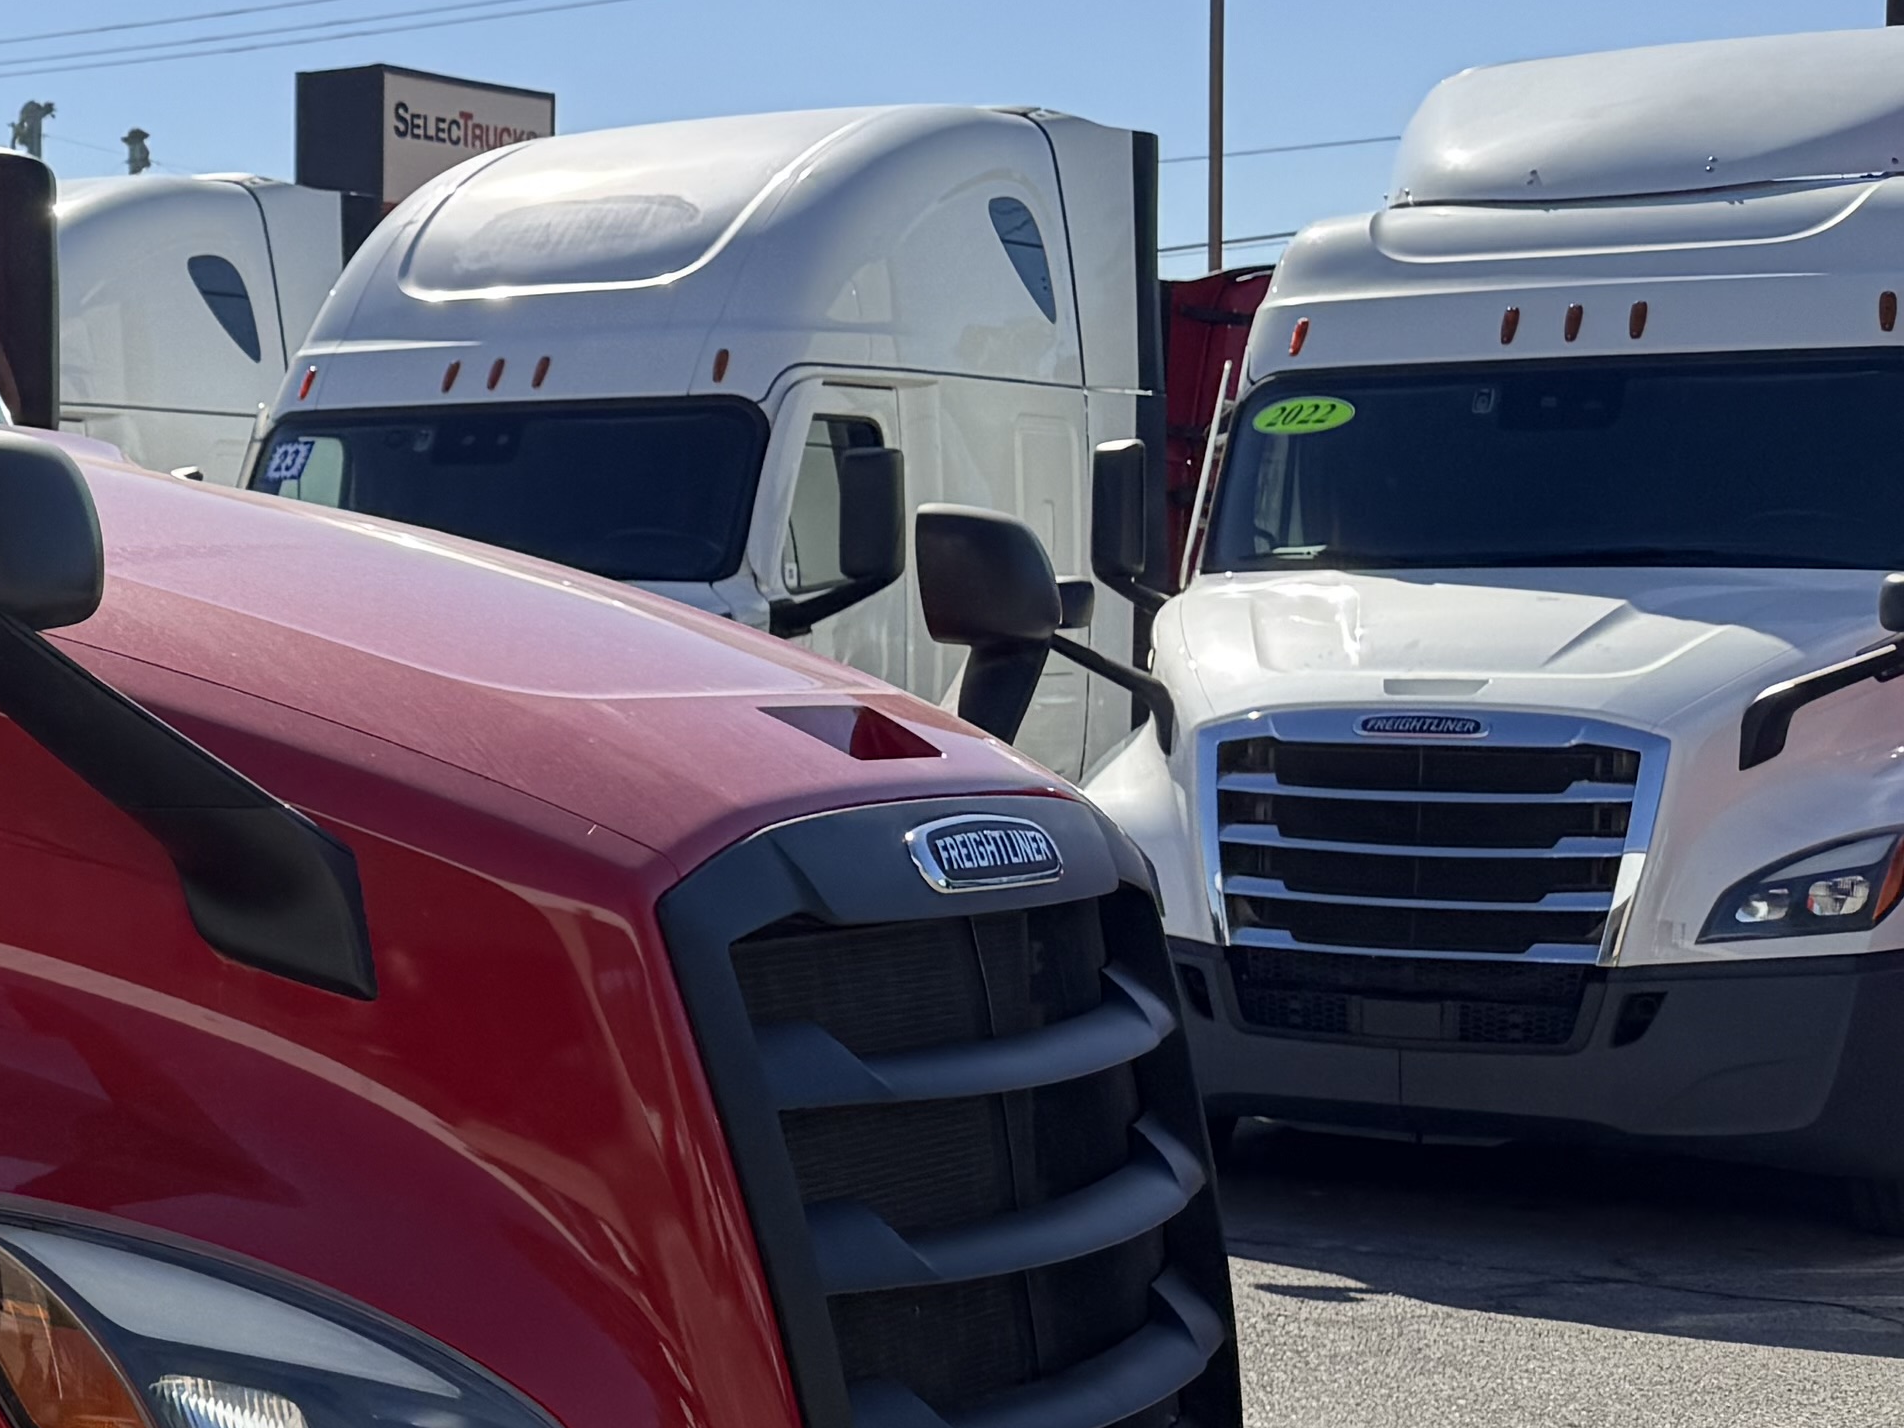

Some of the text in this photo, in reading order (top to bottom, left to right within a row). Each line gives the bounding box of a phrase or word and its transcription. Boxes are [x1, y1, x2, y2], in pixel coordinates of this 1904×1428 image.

[1265, 403, 1337, 428] 2022
[273, 448, 301, 472] 23
[1365, 717, 1476, 732] FREIGHTLINER
[935, 829, 1052, 871] FREIGHTLINER
